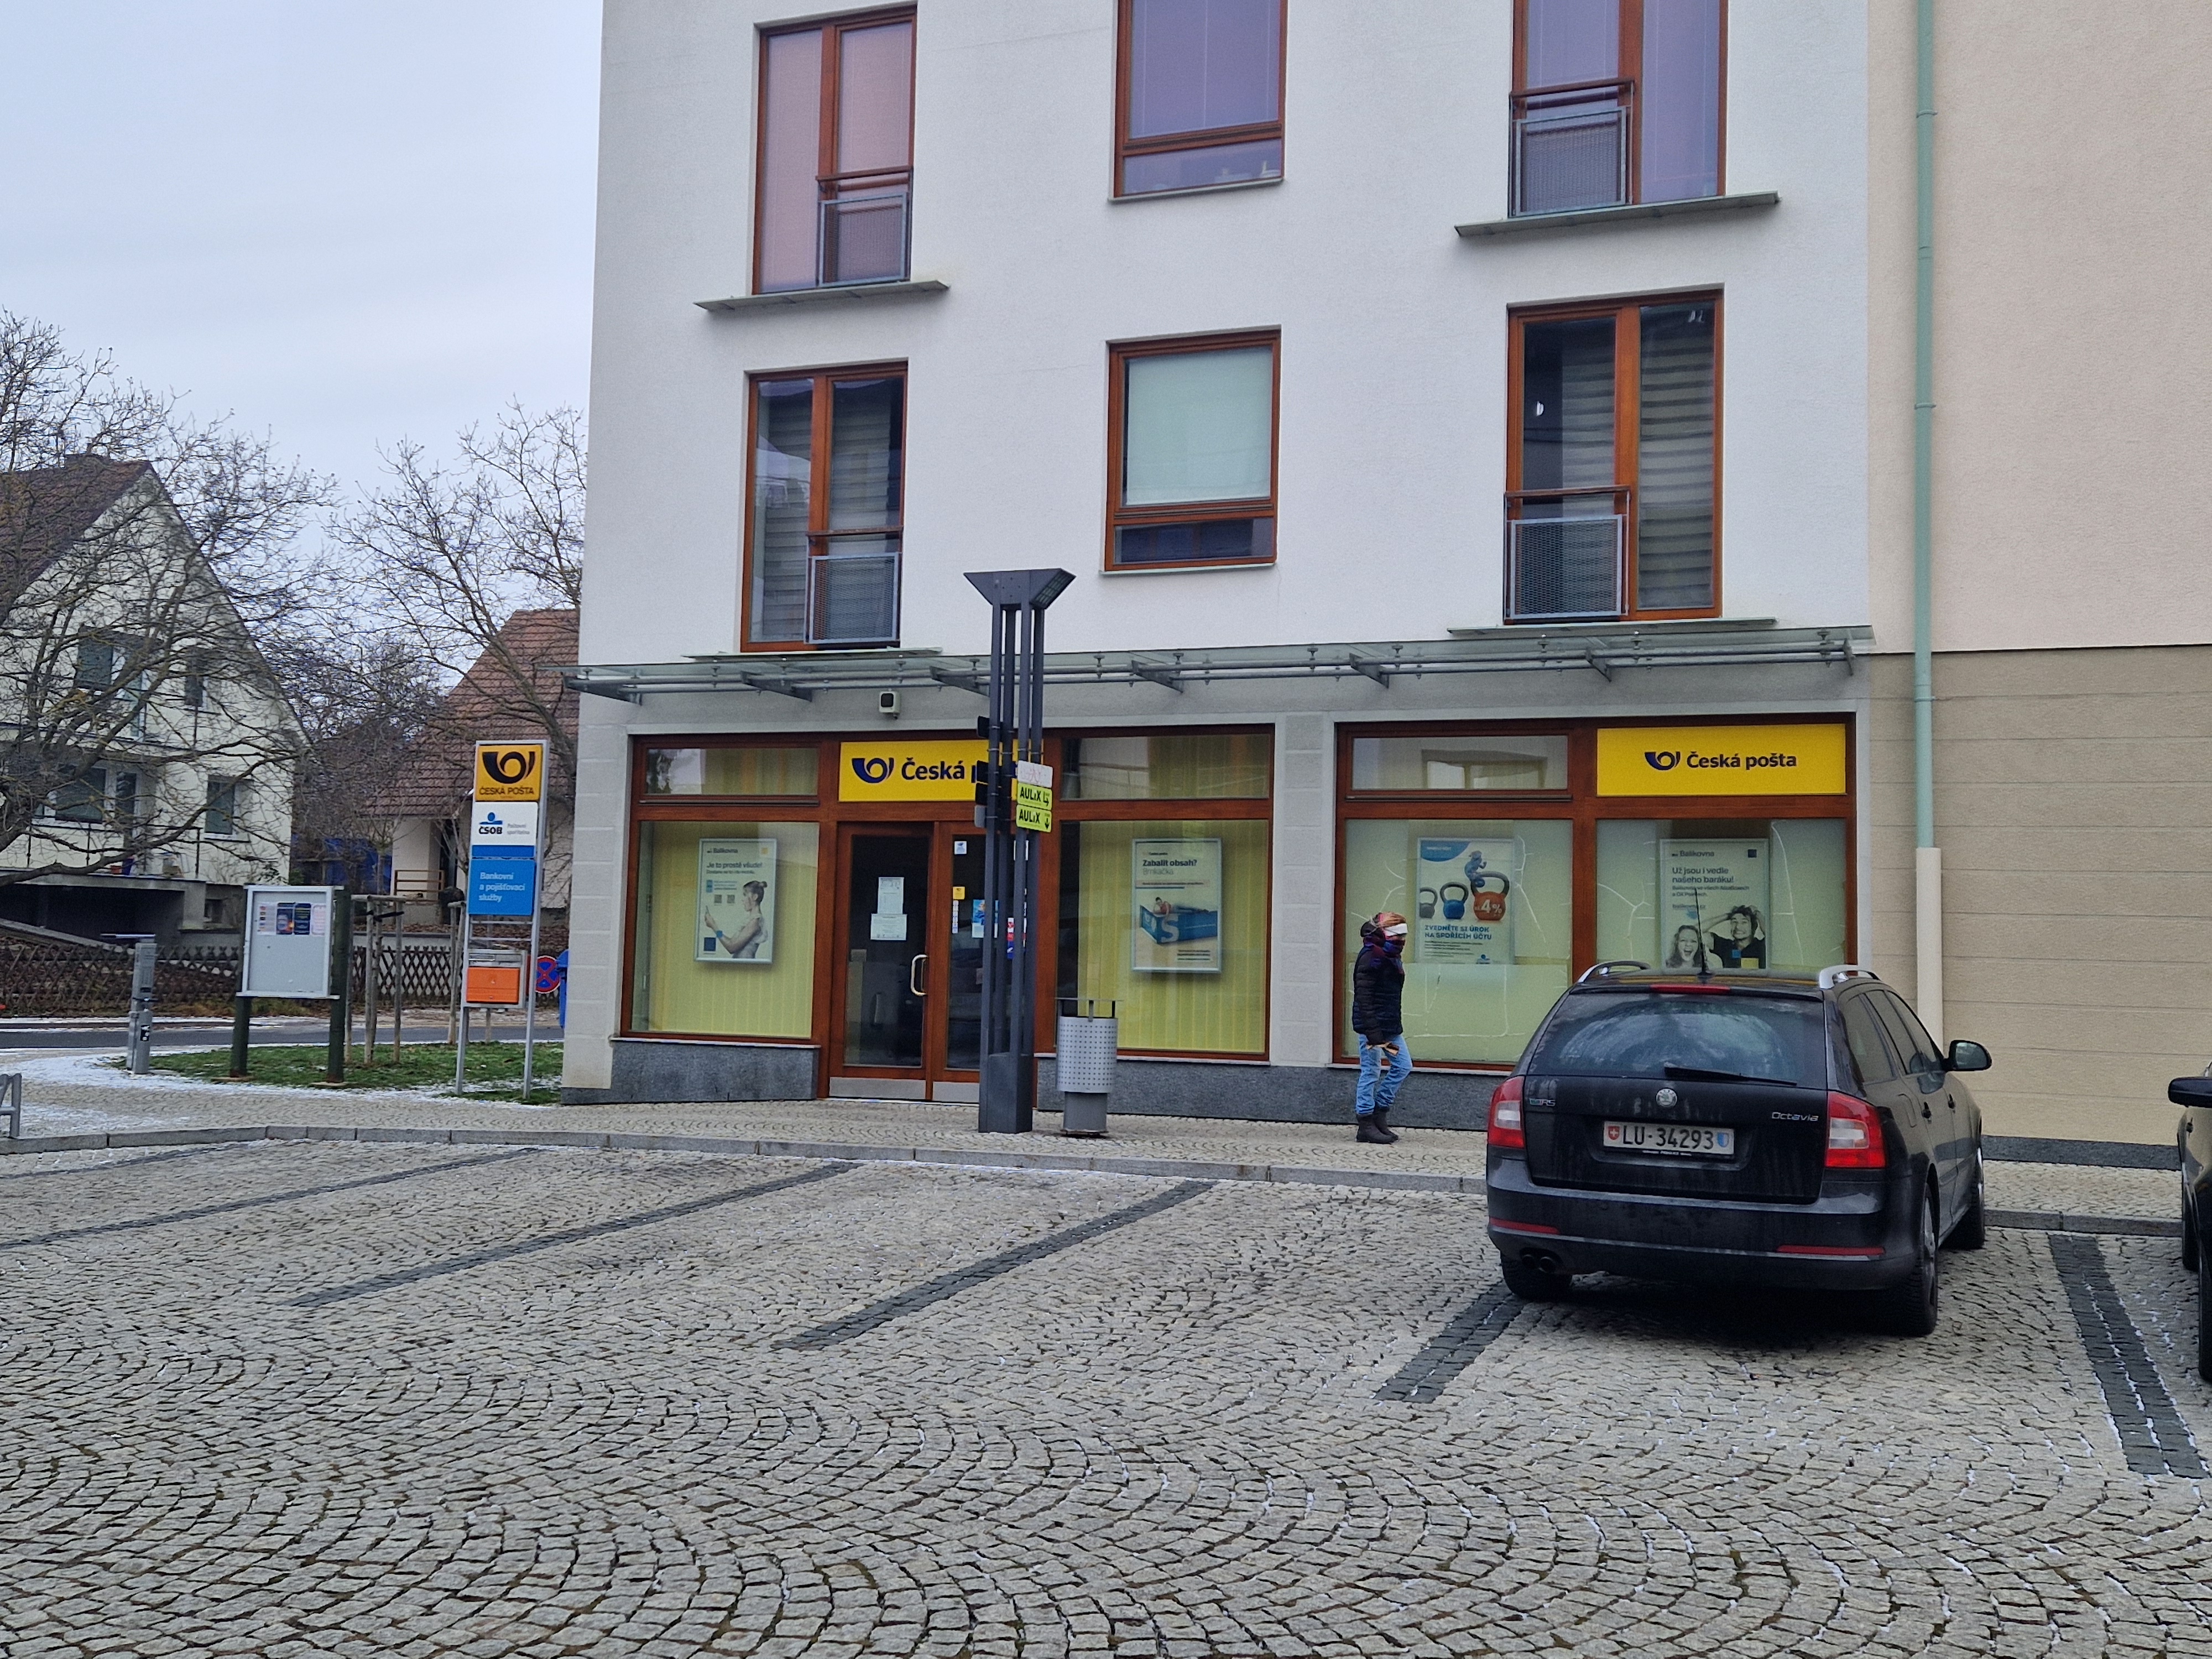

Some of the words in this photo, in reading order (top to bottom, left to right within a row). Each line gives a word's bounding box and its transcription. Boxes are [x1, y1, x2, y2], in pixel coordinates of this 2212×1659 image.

[1687, 751, 1740, 768] Česká
[1746, 753, 1797, 770] pošta
[901, 757, 965, 780] Česká
[479, 785, 505, 795] ČESKÁ
[508, 785, 535, 795] POŠTA
[479, 826, 503, 834] ČSOB
[1481, 899, 1491, 913] 4
[1492, 904, 1503, 914] %
[1772, 1112, 1819, 1121] Octavia
